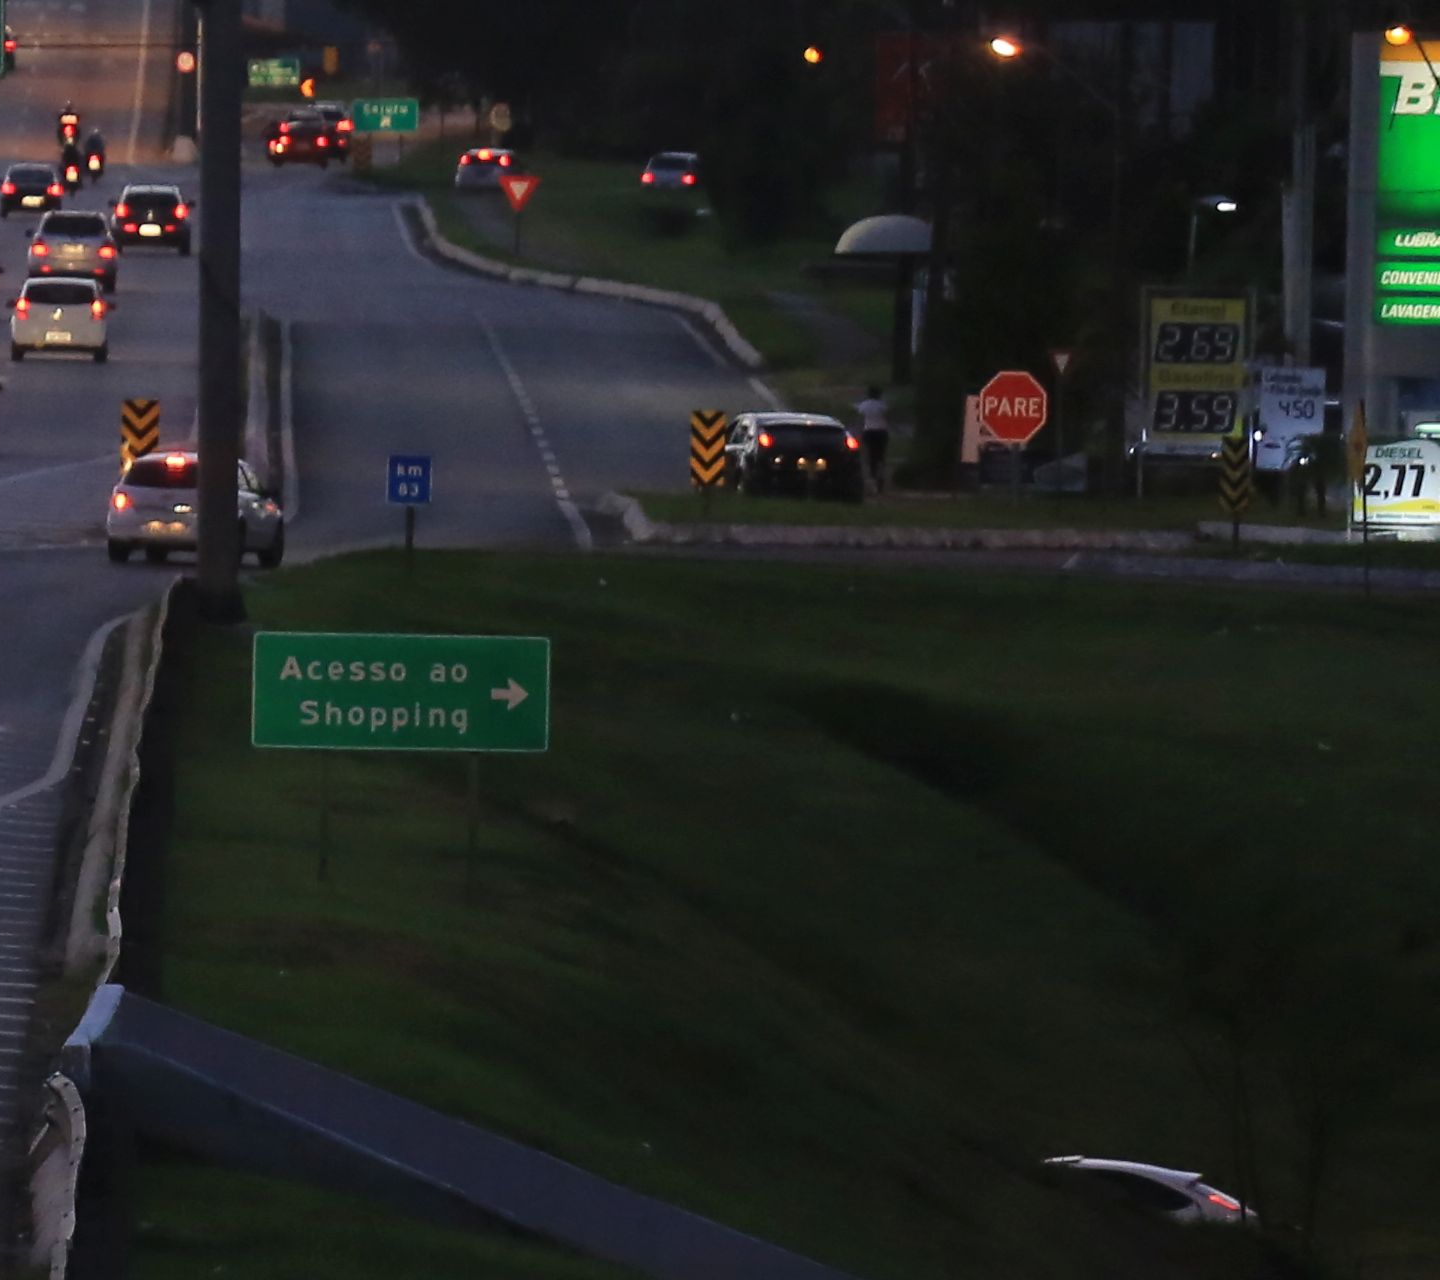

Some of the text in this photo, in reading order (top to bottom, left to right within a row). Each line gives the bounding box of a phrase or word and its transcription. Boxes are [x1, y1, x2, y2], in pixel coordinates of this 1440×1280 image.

[984, 396, 1041, 418] PARE
[1375, 447, 1425, 459] DIESEL
[397, 462, 423, 477] km
[279, 655, 469, 683] Acesso ao
[299, 699, 469, 734] Shopping
